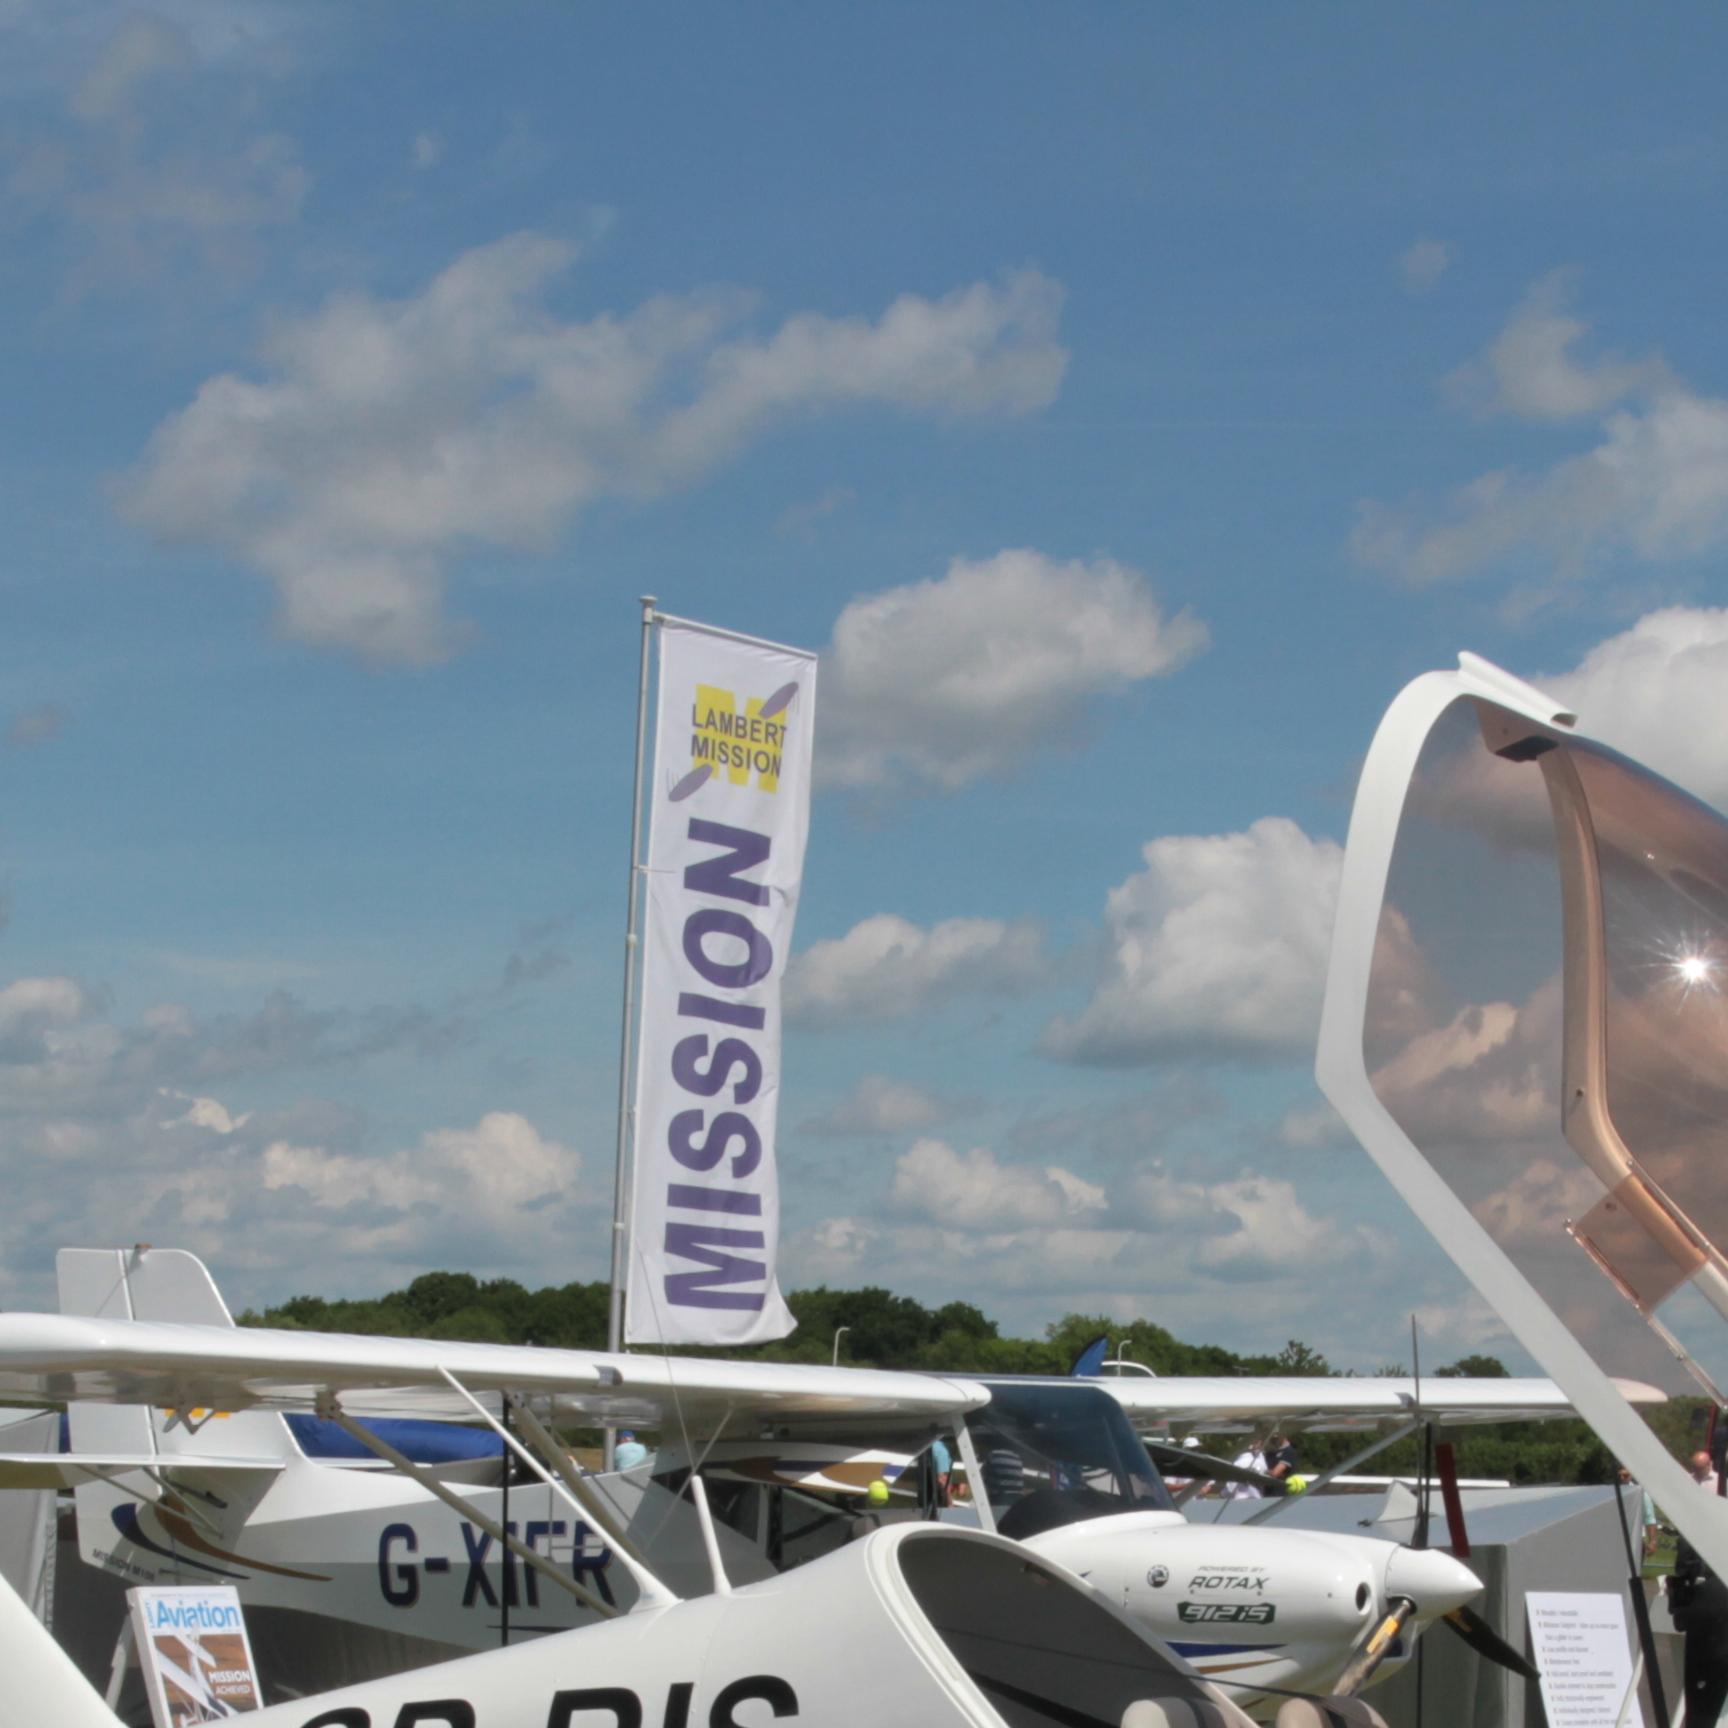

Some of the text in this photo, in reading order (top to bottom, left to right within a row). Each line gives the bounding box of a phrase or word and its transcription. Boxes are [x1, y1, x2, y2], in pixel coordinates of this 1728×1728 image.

[691, 704, 788, 749] LAMBERT
[690, 734, 782, 778] MISSION
[663, 817, 774, 1312] MISSION
[1188, 1576, 1269, 1590] ROTAX
[156, 1599, 241, 1629] Aviation
[1182, 1605, 1237, 1621] 912
[207, 1670, 251, 1683] MISSION
